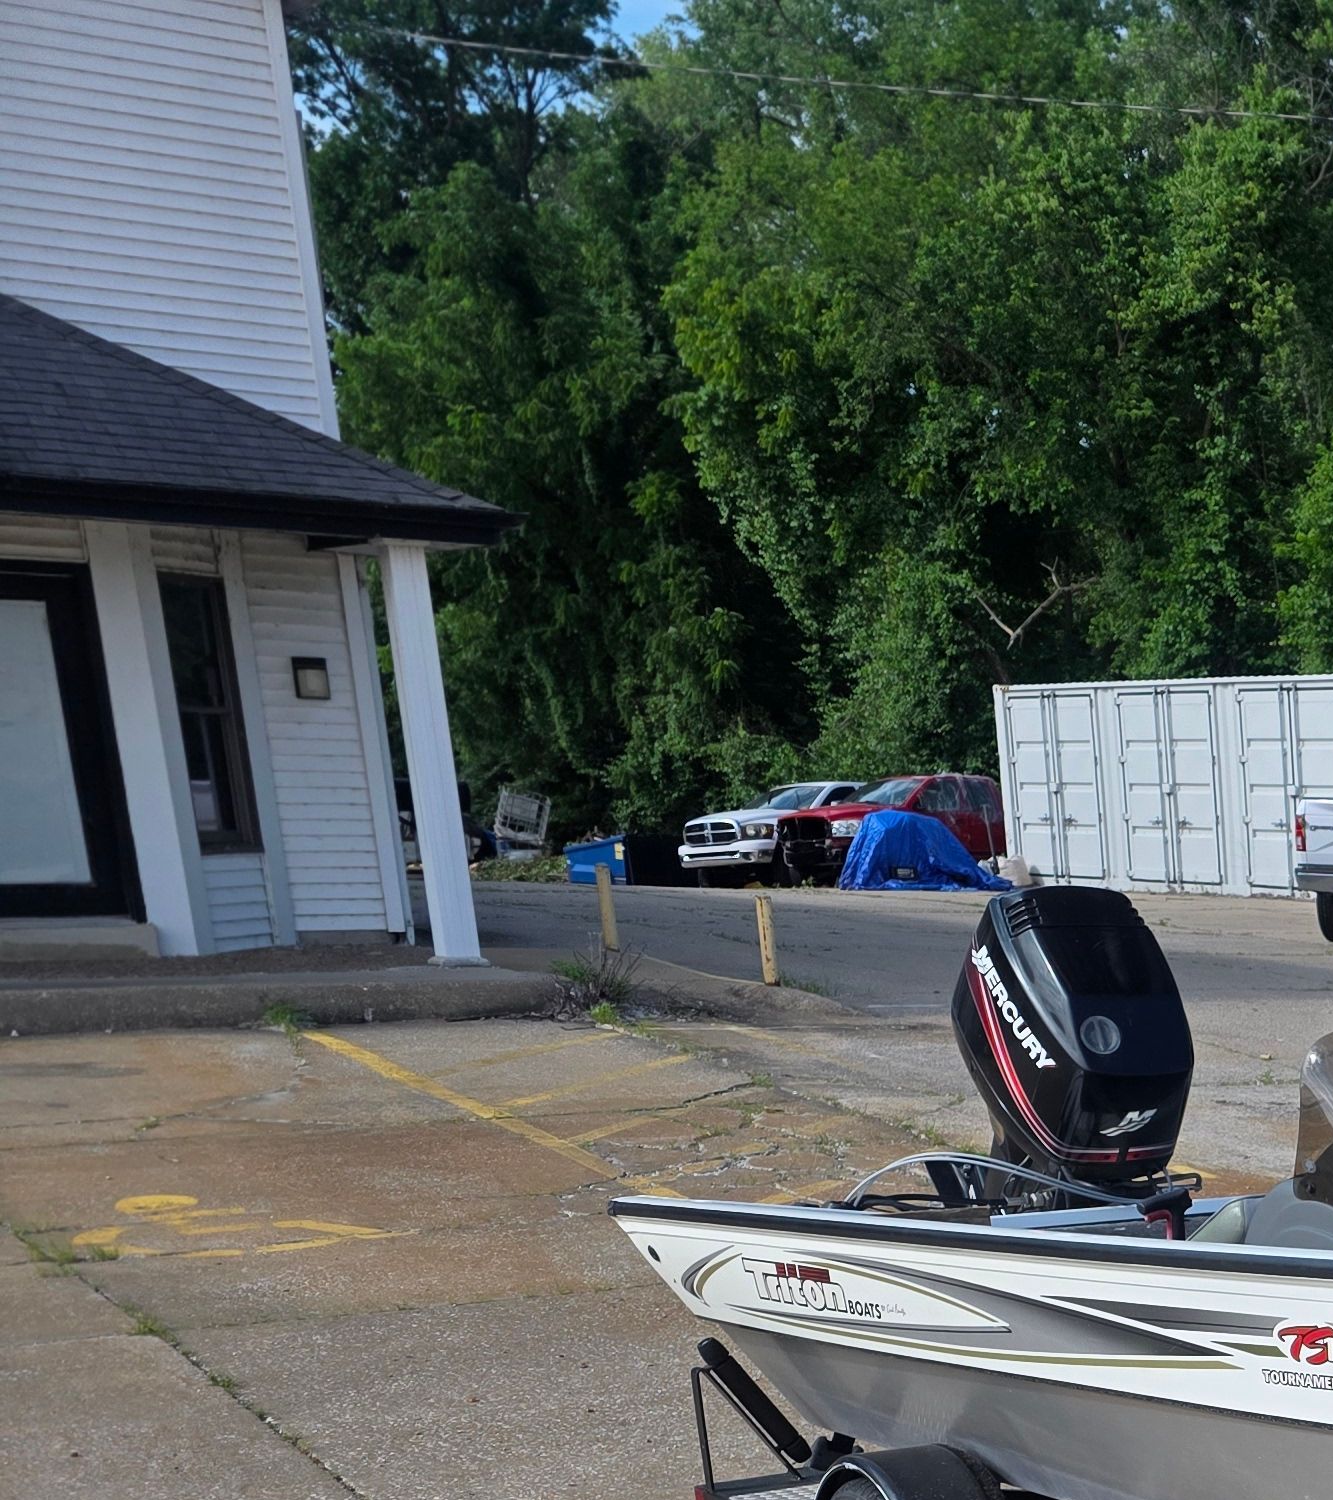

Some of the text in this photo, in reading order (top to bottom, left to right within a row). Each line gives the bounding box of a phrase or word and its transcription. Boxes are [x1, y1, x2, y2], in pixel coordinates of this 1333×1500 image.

[972, 945, 1056, 1069] MERCURY
[741, 1257, 882, 1319] Triton BOATS
